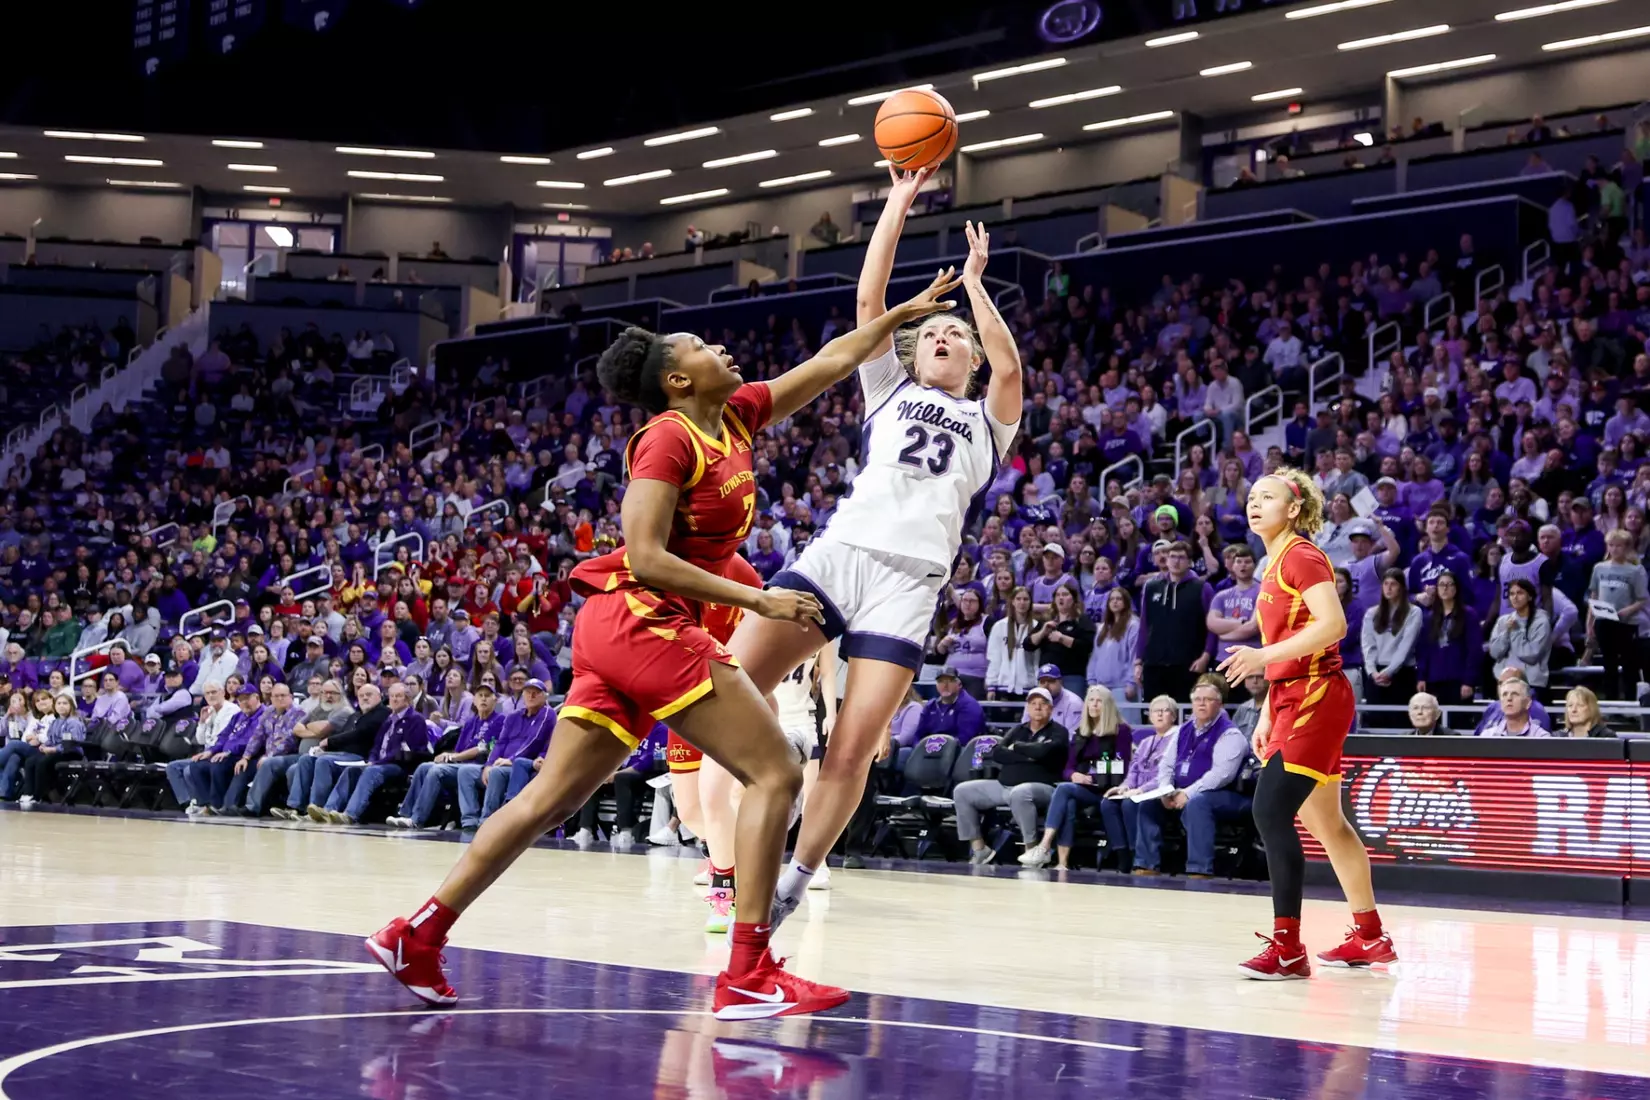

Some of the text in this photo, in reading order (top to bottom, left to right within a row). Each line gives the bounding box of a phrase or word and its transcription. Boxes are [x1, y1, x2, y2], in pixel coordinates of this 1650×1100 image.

[897, 400, 973, 445] Wildcats
[898, 424, 956, 477] 23
[719, 474, 742, 499] IOWA
[669, 749, 691, 757] STATE
